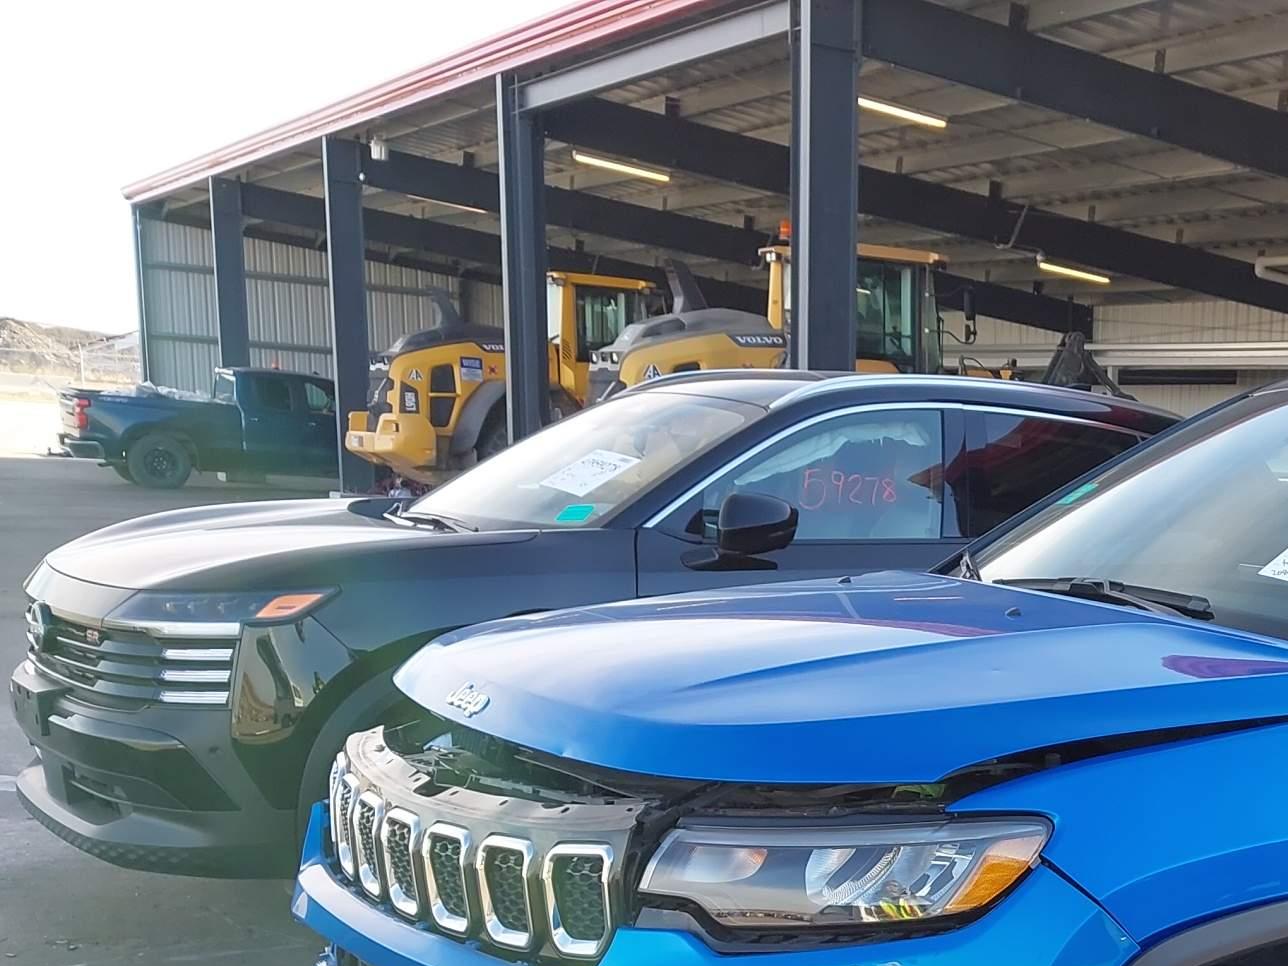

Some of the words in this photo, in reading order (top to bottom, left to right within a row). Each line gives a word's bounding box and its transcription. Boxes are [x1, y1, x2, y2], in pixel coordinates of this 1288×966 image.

[482, 343, 505, 351] VOL
[735, 335, 783, 345] VOLVO
[799, 468, 896, 511] 59278
[446, 680, 490, 719] Jeep
